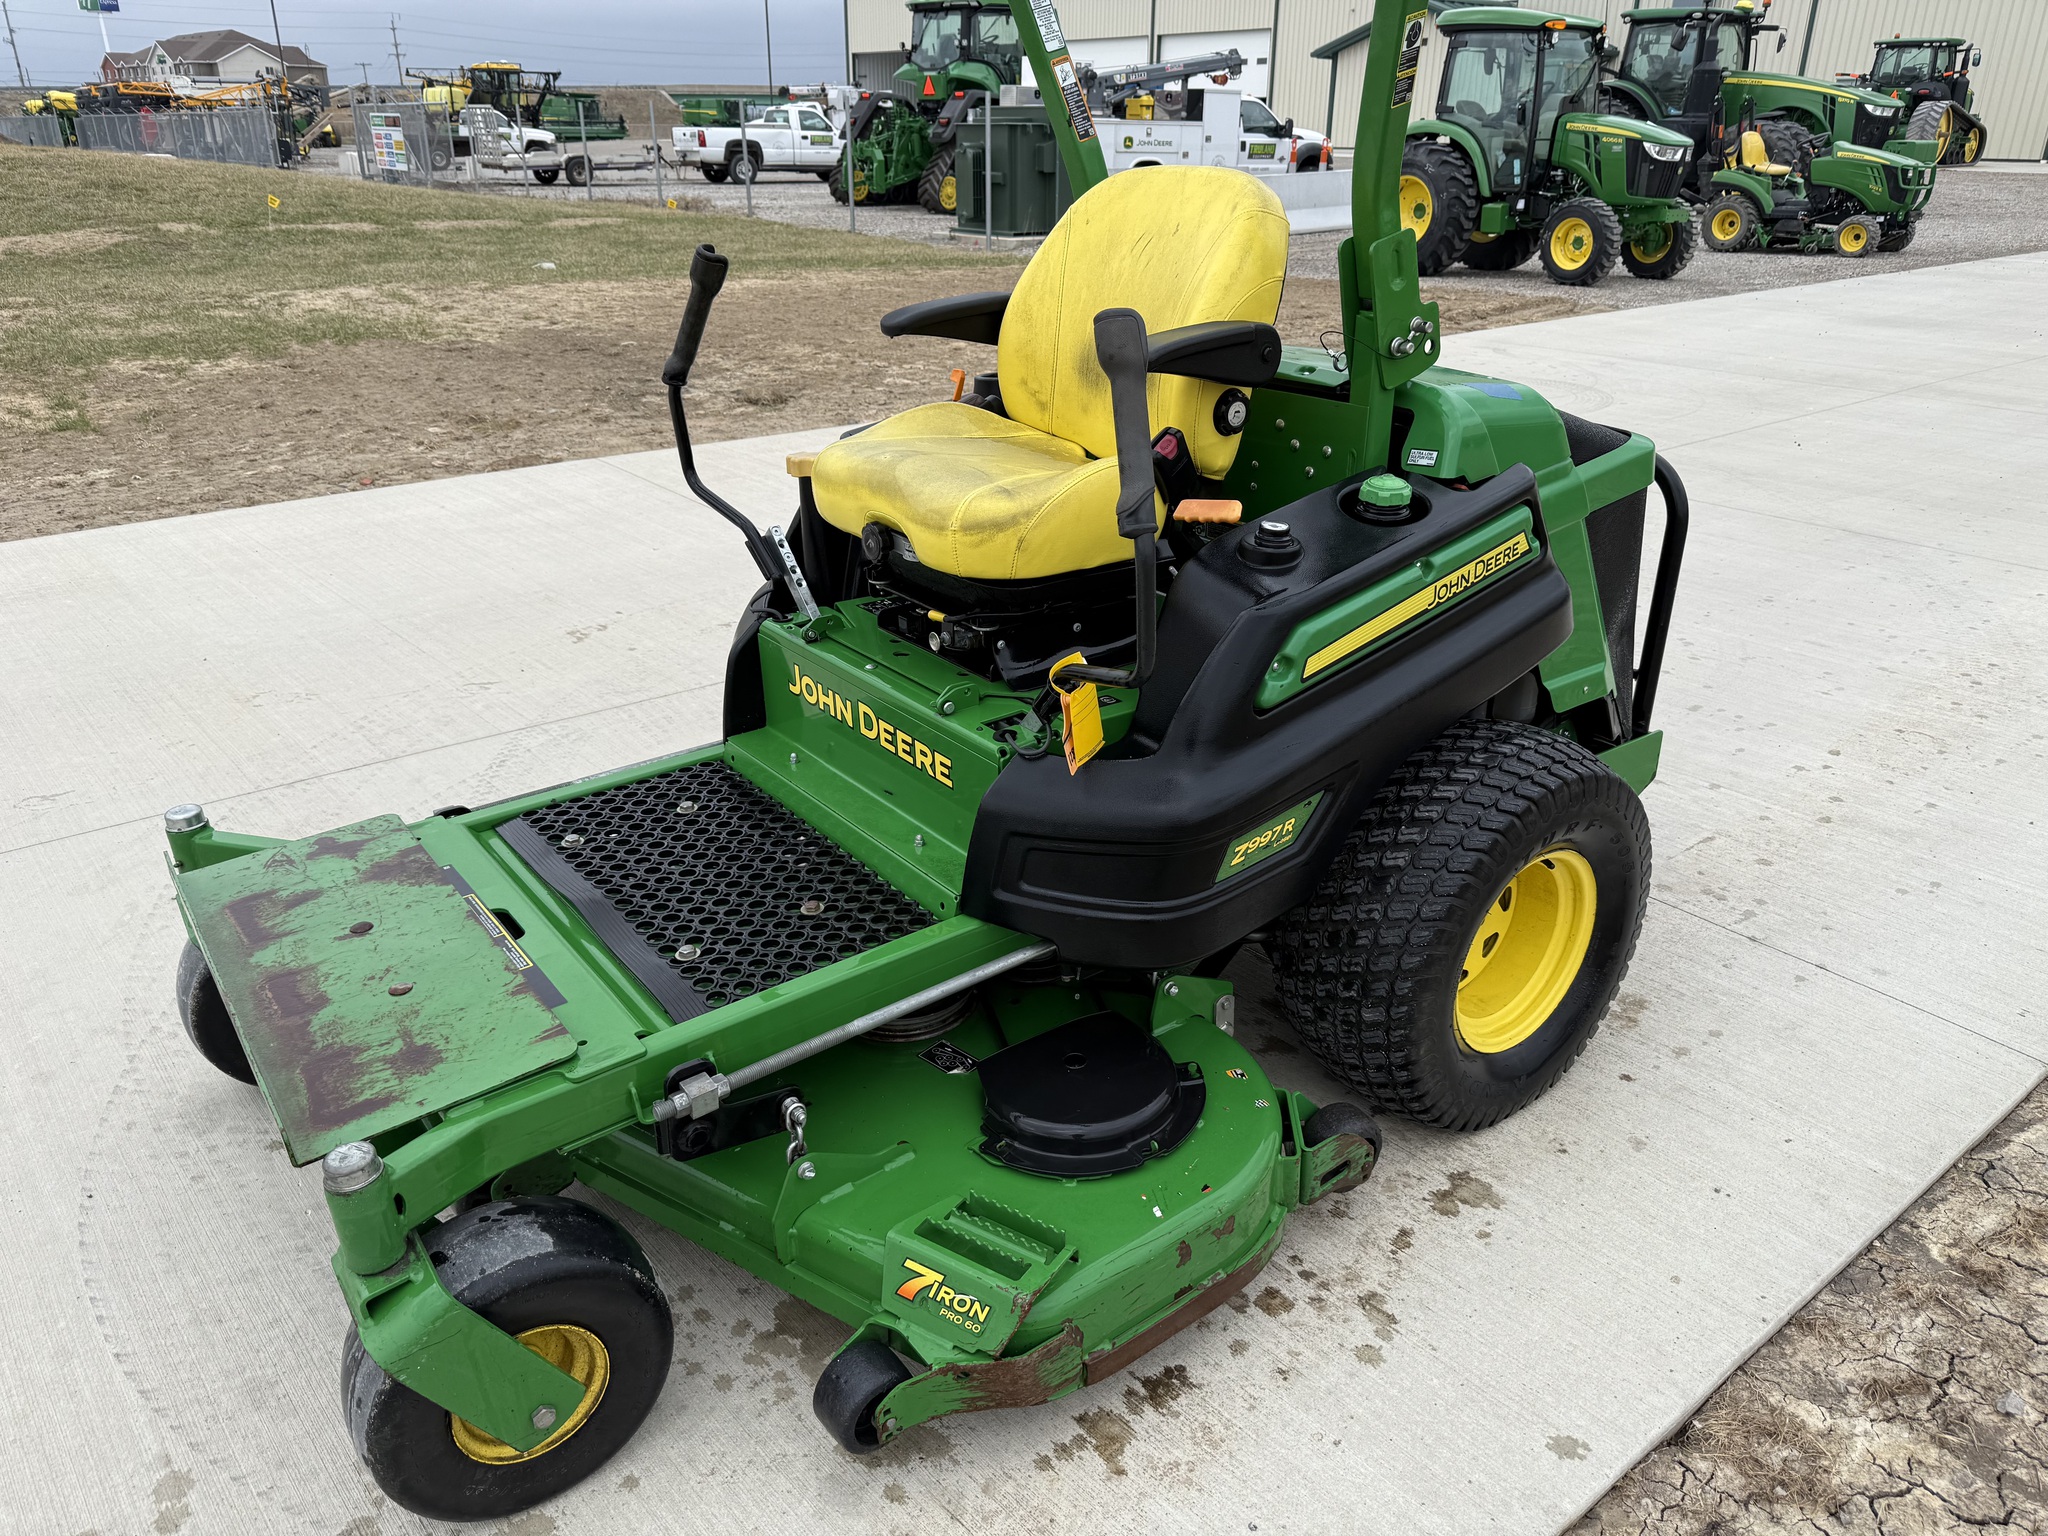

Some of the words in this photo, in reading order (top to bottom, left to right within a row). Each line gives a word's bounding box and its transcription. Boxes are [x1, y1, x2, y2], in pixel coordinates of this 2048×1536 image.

[1136, 138, 1153, 146] JOHN
[1153, 138, 1173, 146] DEERE
[1427, 569, 1471, 608] JOHN
[1474, 541, 1520, 582] DEERE
[788, 663, 854, 730] JOHN
[857, 699, 954, 790] DEERE
[1230, 817, 1296, 867] Z997R
[895, 1257, 946, 1302] 7
[927, 1280, 992, 1326] IRON
[939, 1307, 963, 1325] PRO
[964, 1320, 981, 1333] 60
